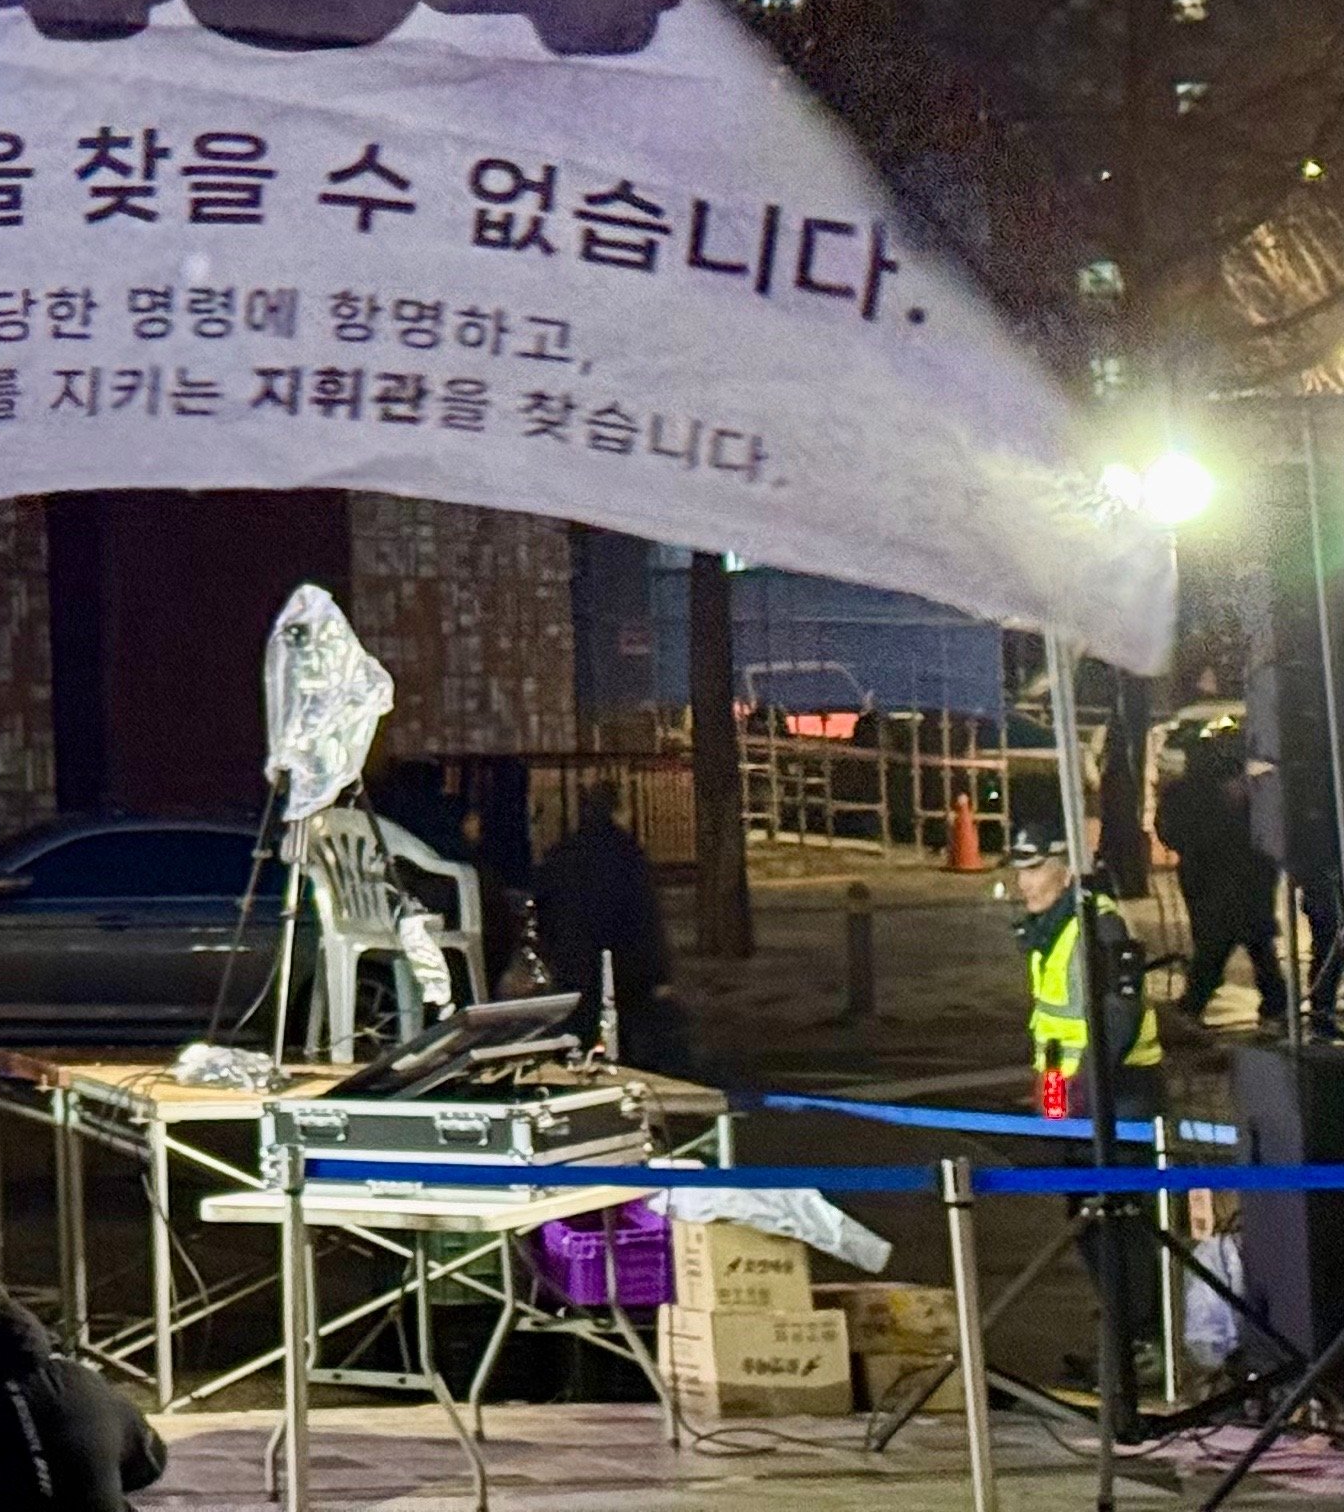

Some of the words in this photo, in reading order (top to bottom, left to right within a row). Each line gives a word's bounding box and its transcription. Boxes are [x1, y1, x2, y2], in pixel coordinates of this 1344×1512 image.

[75, 126, 277, 224] 찾을
[318, 143, 416, 233] 수
[469, 158, 926, 322] 없습니다.
[128, 287, 298, 340] 명령에
[329, 289, 593, 376] 항명하고,
[51, 366, 222, 418] 지키는
[251, 365, 491, 432] 지휘관을
[520, 390, 789, 489] 찾습니다.
